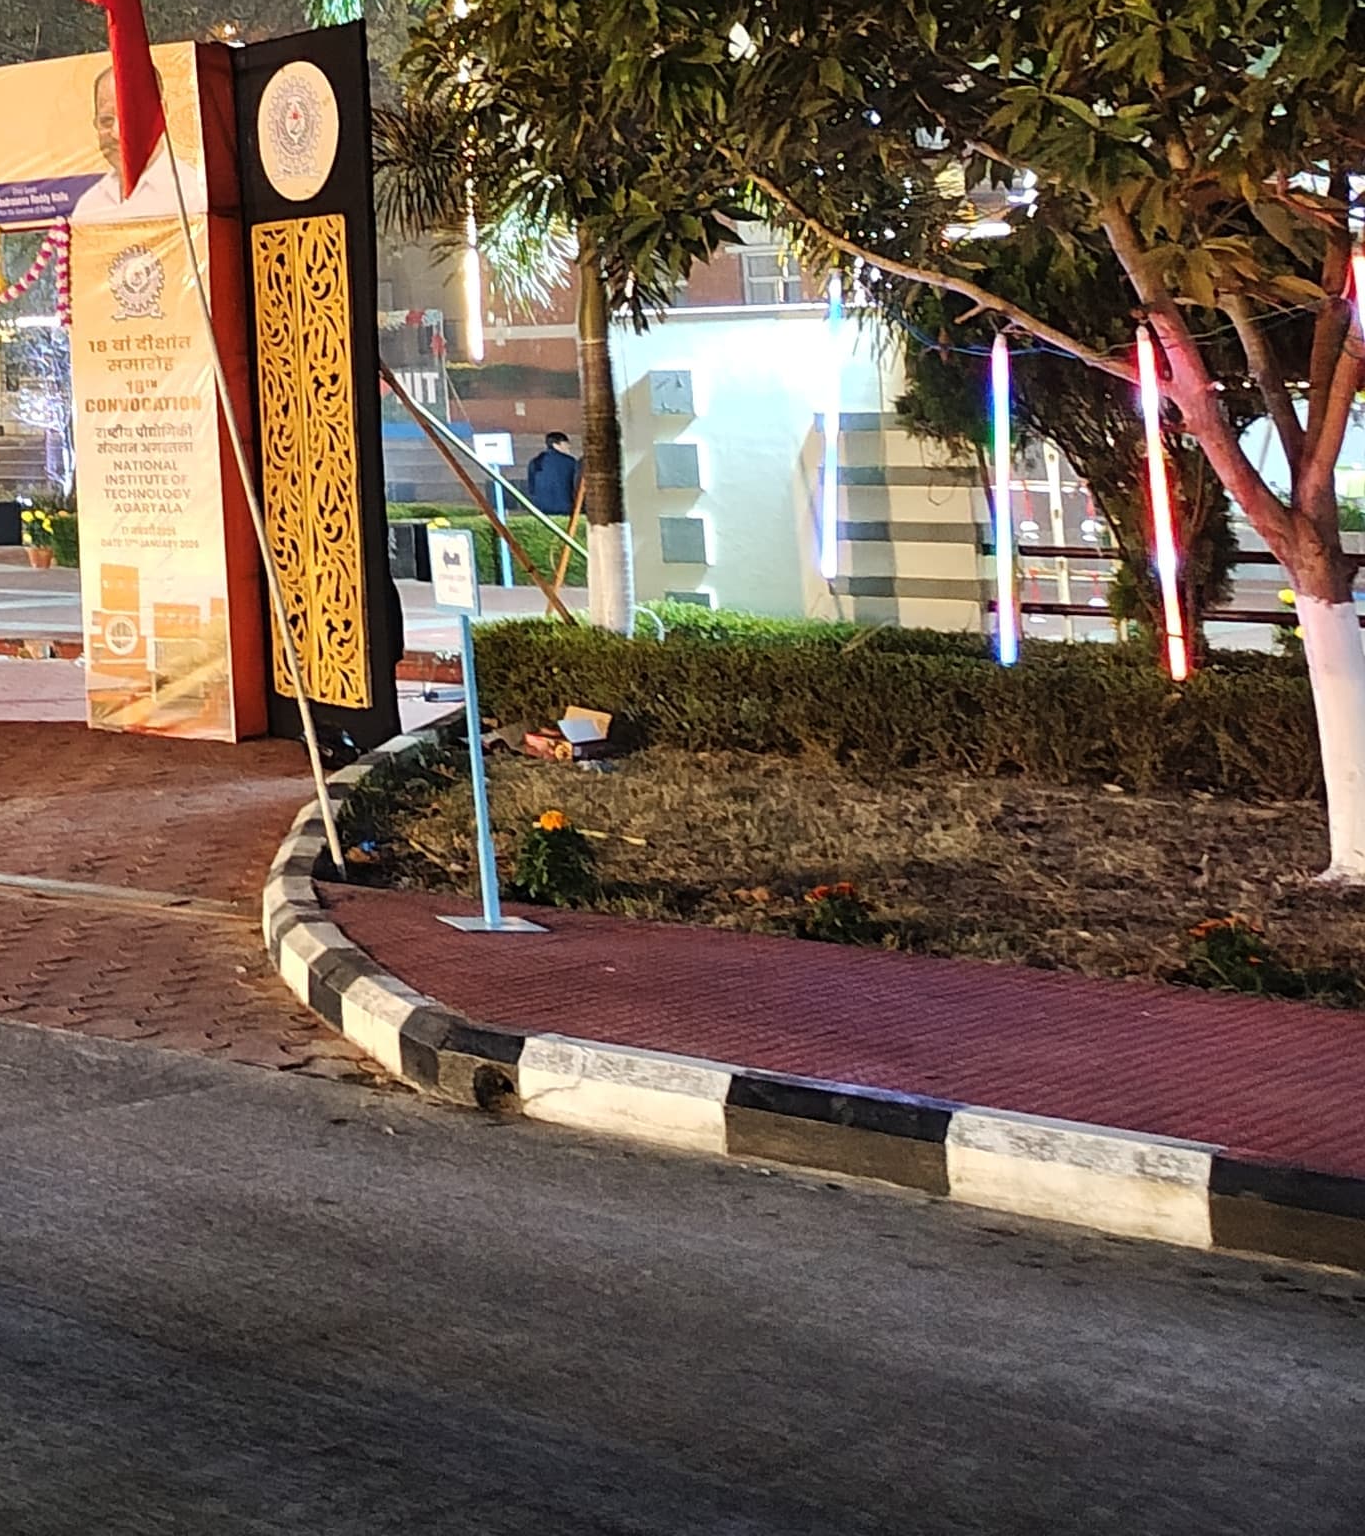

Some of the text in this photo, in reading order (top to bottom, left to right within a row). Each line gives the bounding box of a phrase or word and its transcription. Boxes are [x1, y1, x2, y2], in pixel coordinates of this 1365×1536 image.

[88, 339, 107, 353] 18
[85, 396, 202, 413] CONVOCATION
[113, 459, 178, 471] NATIONAL
[105, 474, 189, 485] INSTITUTE OF
[104, 488, 191, 500] TECHNOLOGY
[114, 502, 183, 513] AGARTALA
